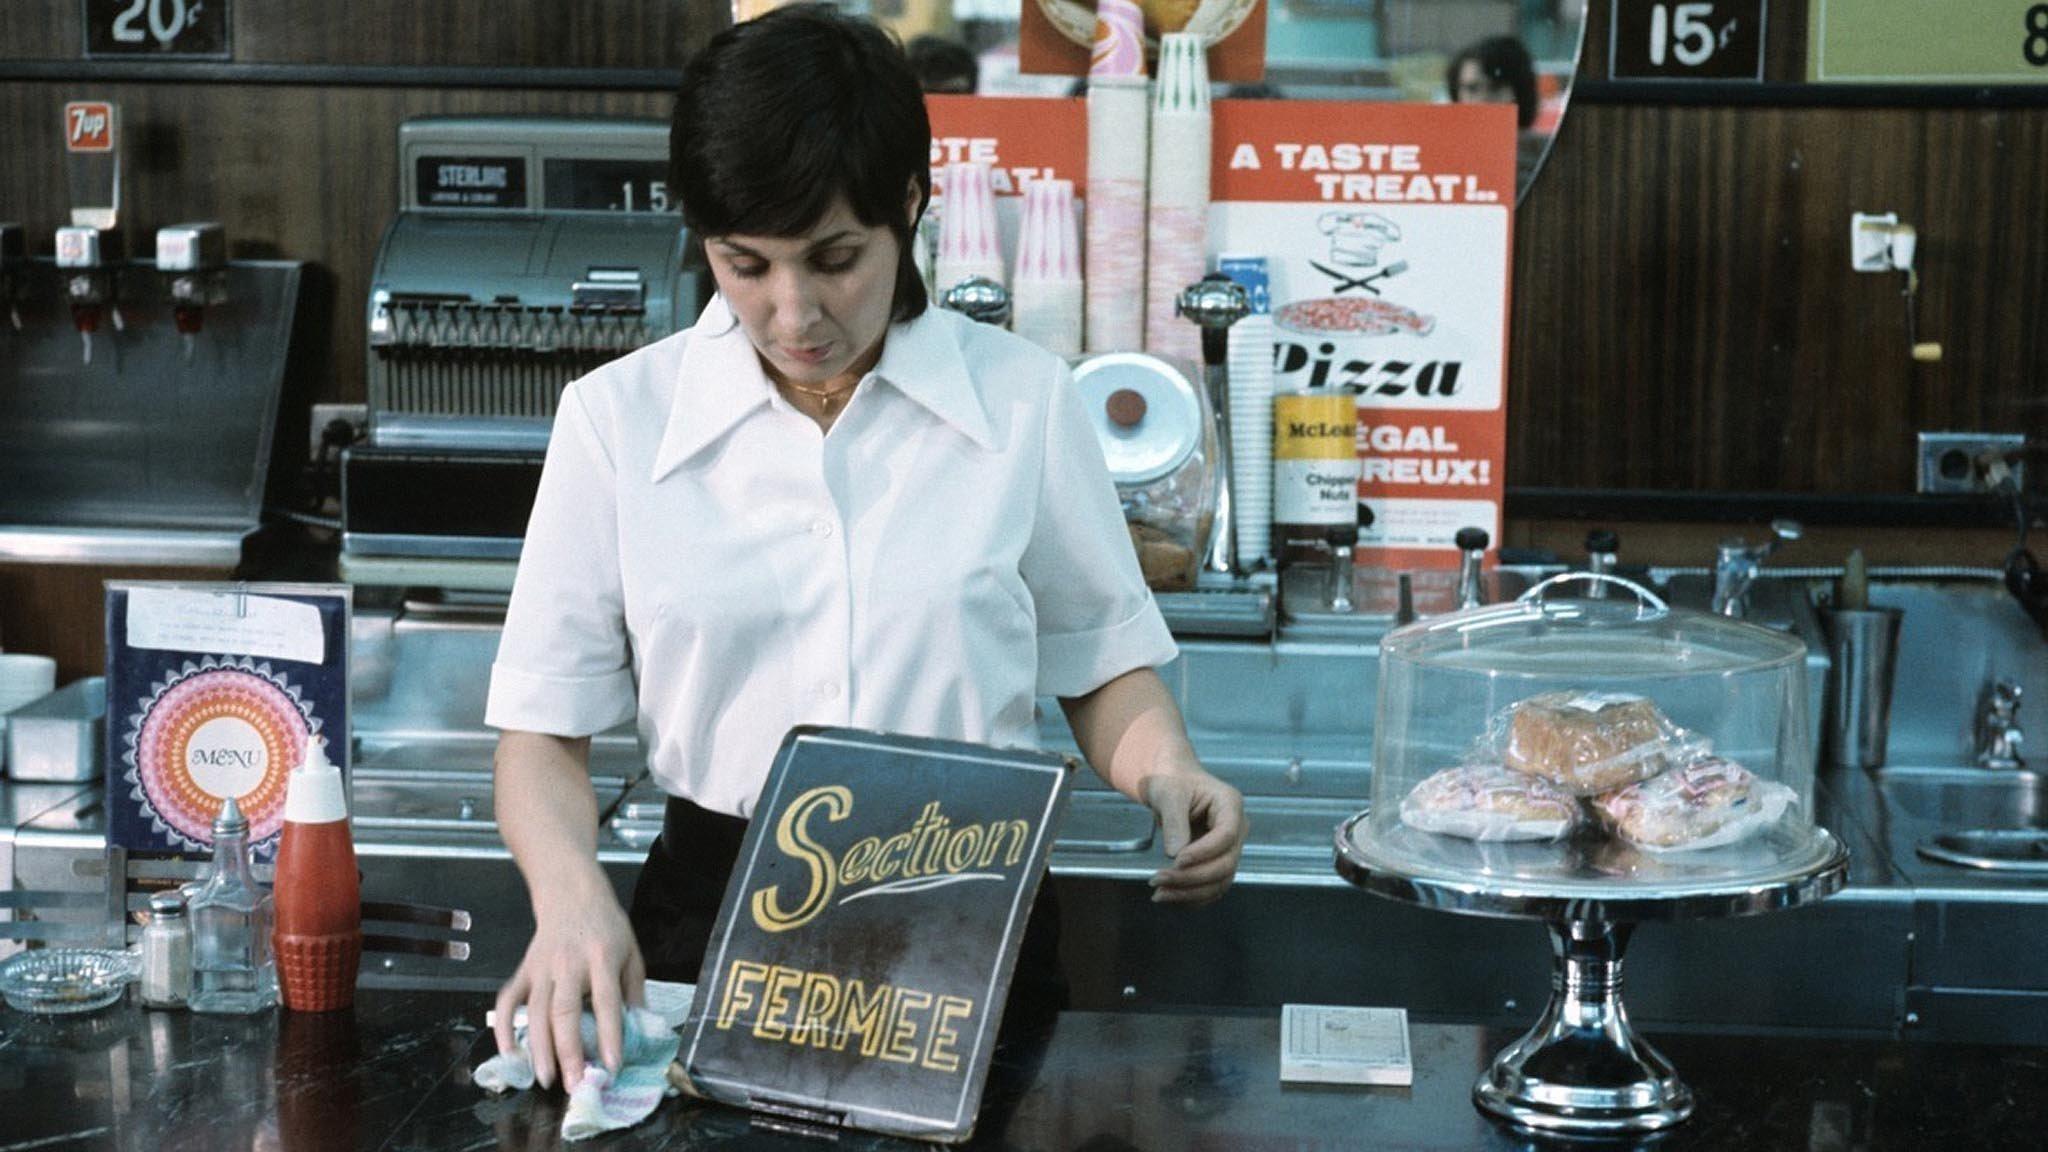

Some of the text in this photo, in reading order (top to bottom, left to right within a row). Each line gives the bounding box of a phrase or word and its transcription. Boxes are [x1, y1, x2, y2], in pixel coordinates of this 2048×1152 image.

[2023, 3, 2048, 67] 8
[71, 108, 106, 142] 7up
[1230, 144, 1421, 171] A TASTE
[438, 165, 507, 187] STERLING
[1273, 342, 1463, 397] Pizza
[1305, 473, 1356, 487] Chippe
[1320, 489, 1349, 500] Nuts
[191, 748, 262, 769] MENU
[752, 785, 1029, 933] Section
[716, 959, 974, 1072] FERMEE
